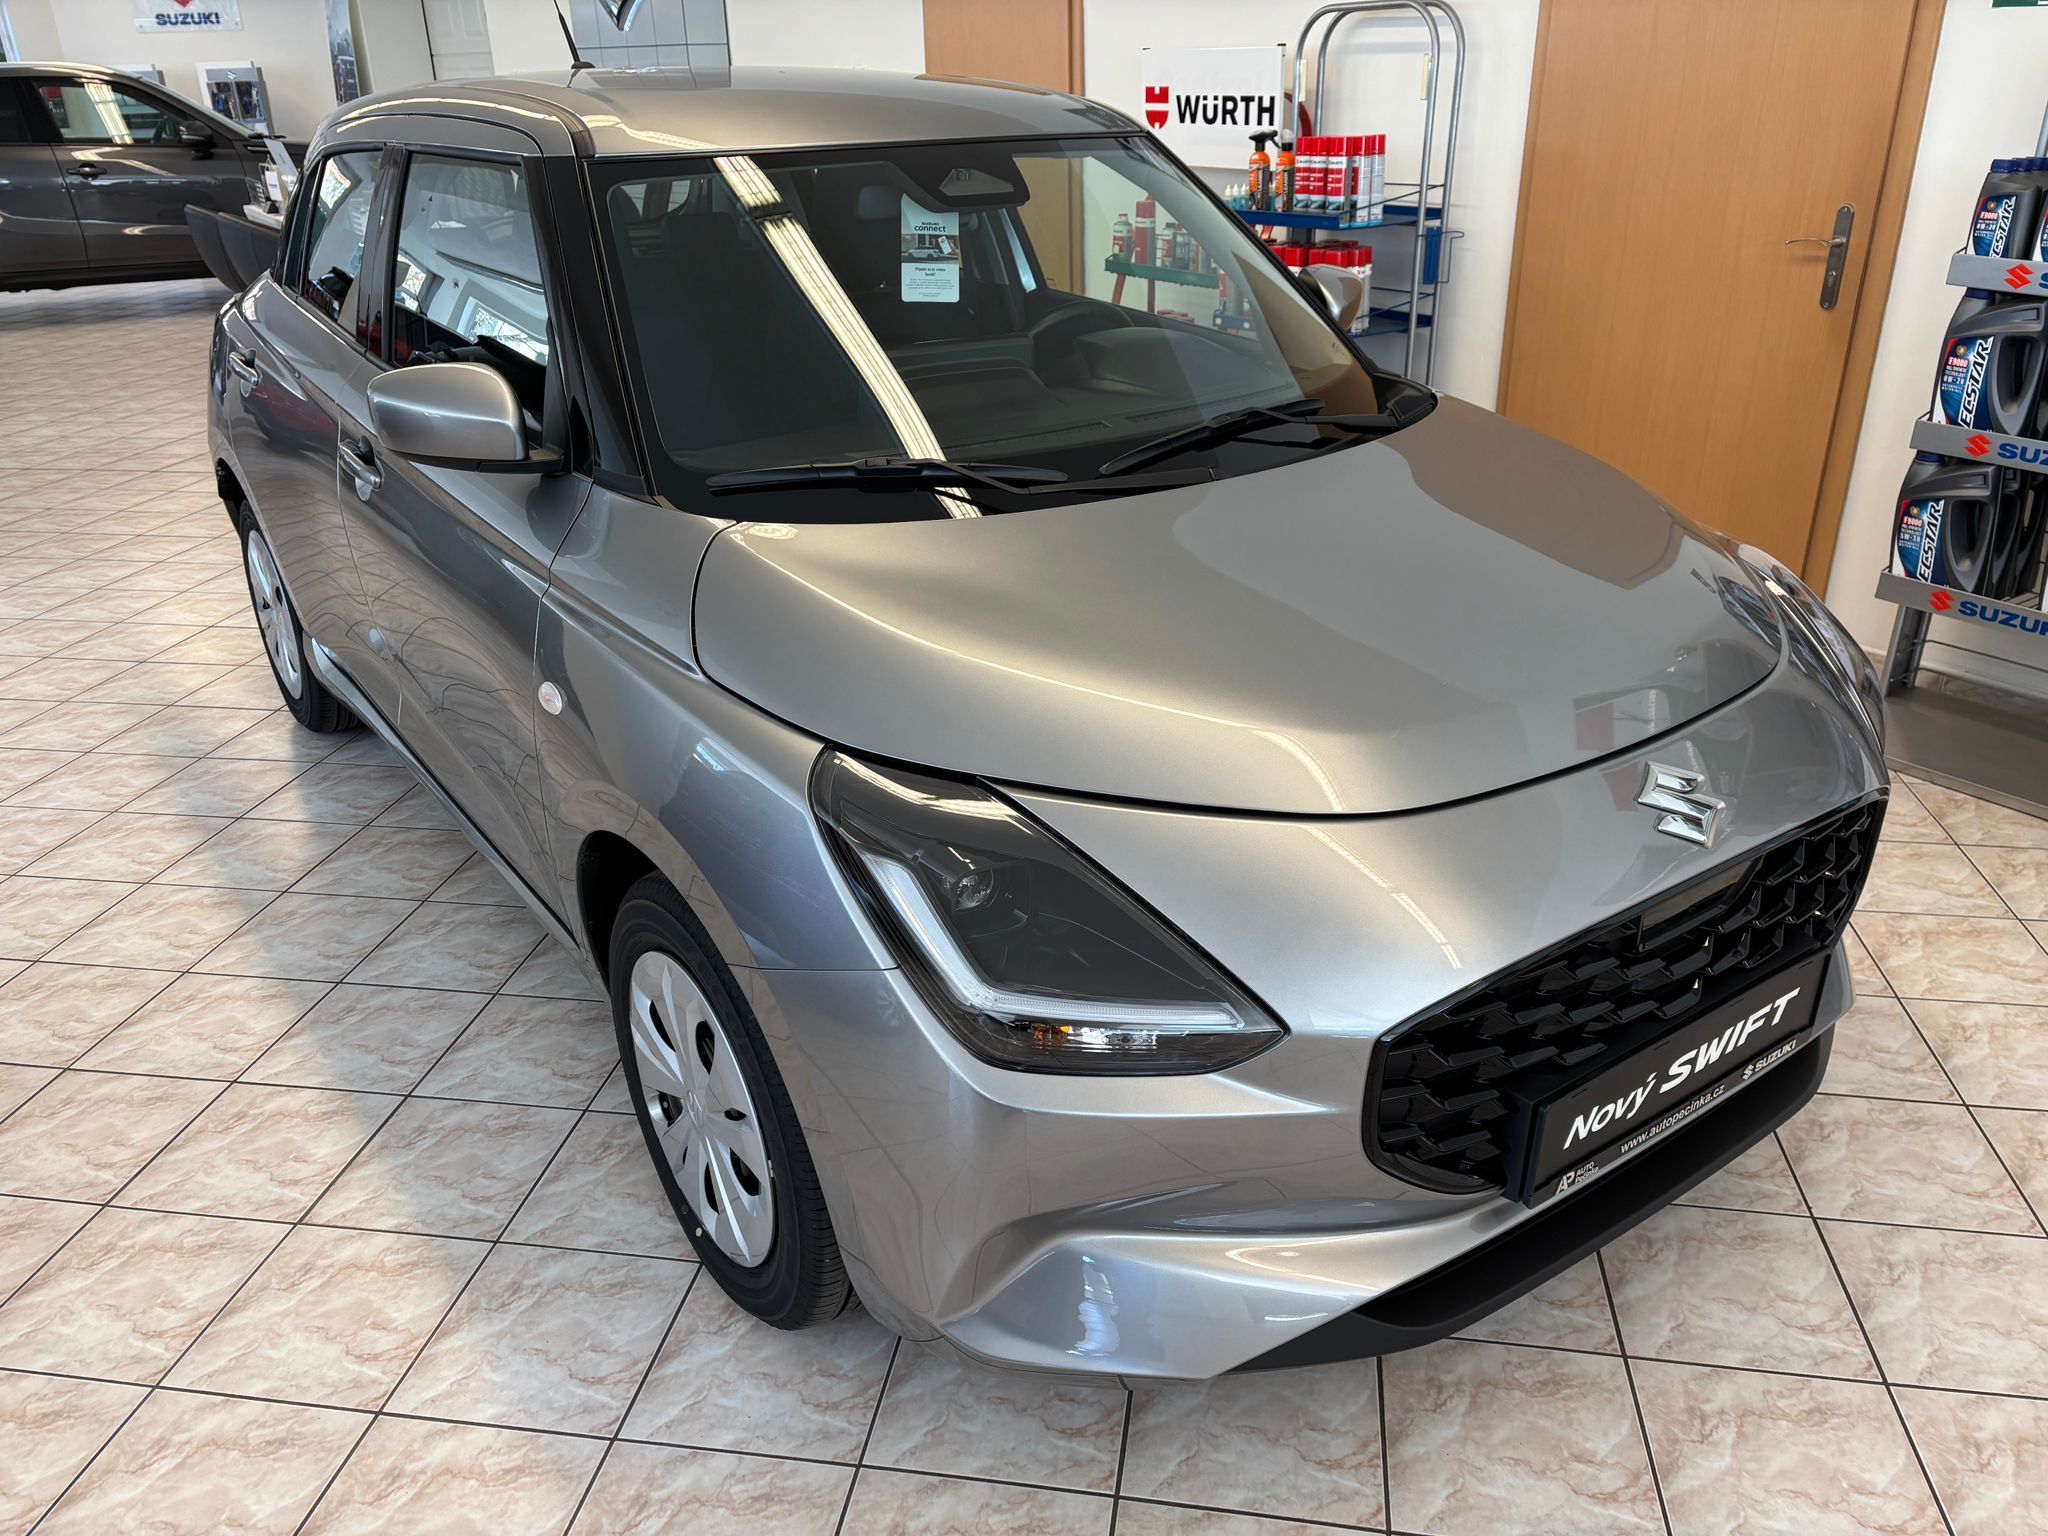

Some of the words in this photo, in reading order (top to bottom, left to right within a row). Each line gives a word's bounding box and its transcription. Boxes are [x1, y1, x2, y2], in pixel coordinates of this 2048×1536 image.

[155, 12, 221, 26] SUZUKI
[1176, 94, 1275, 126] WÜRTH
[914, 225, 946, 233] connect
[1563, 1072, 1656, 1150] Nový
[1659, 986, 1801, 1093] SWIFT
[1754, 1039, 1797, 1072] SUZUKI
[1620, 1085, 1726, 1153] www.autopecinka.cz
